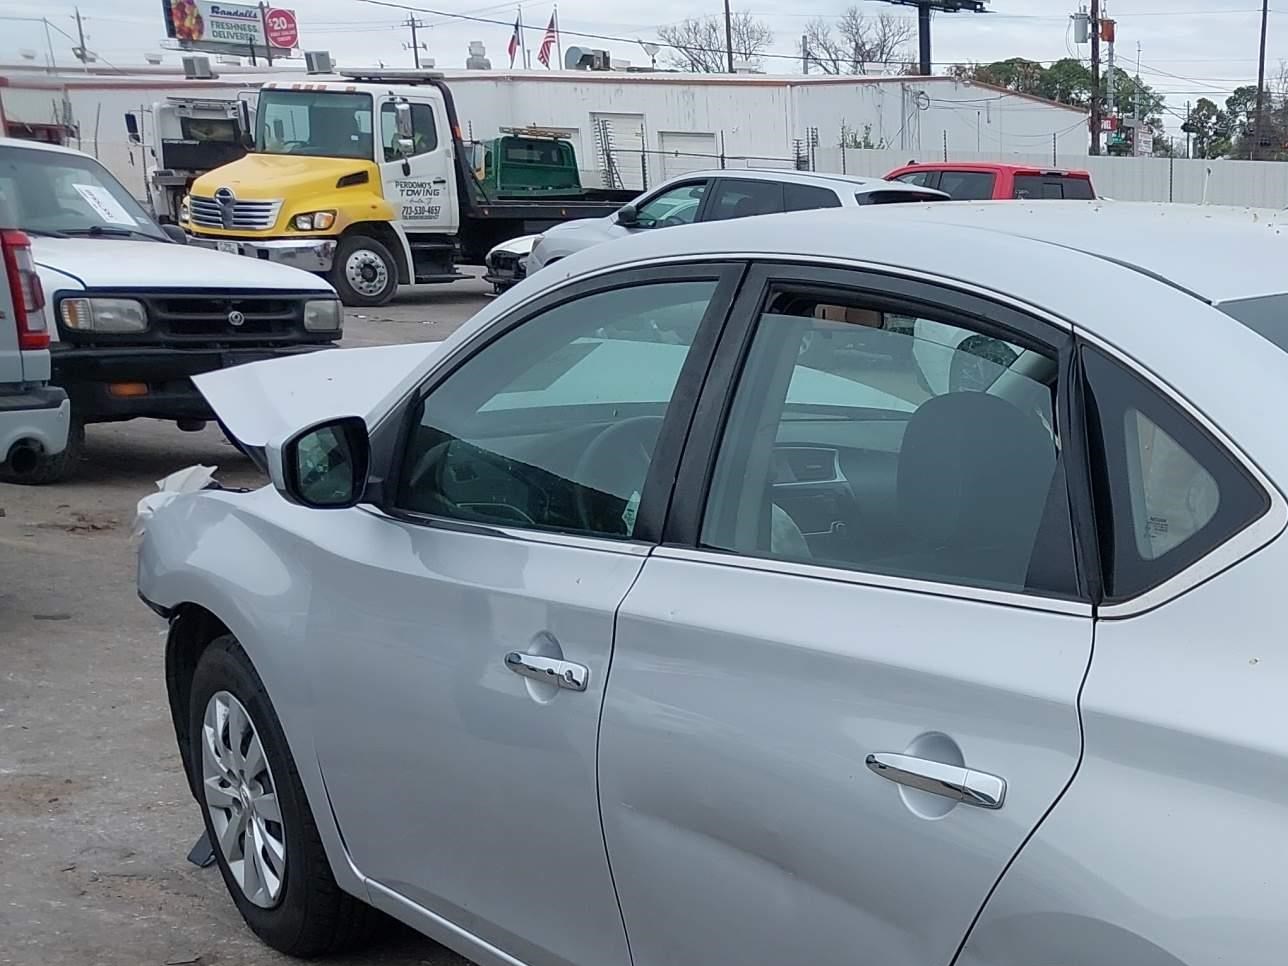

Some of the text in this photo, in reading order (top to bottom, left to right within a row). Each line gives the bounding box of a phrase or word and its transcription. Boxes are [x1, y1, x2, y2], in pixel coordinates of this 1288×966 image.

[211, 5, 257, 19] Randalls
[268, 16, 288, 31] $20
[400, 188, 440, 197] TOWING
